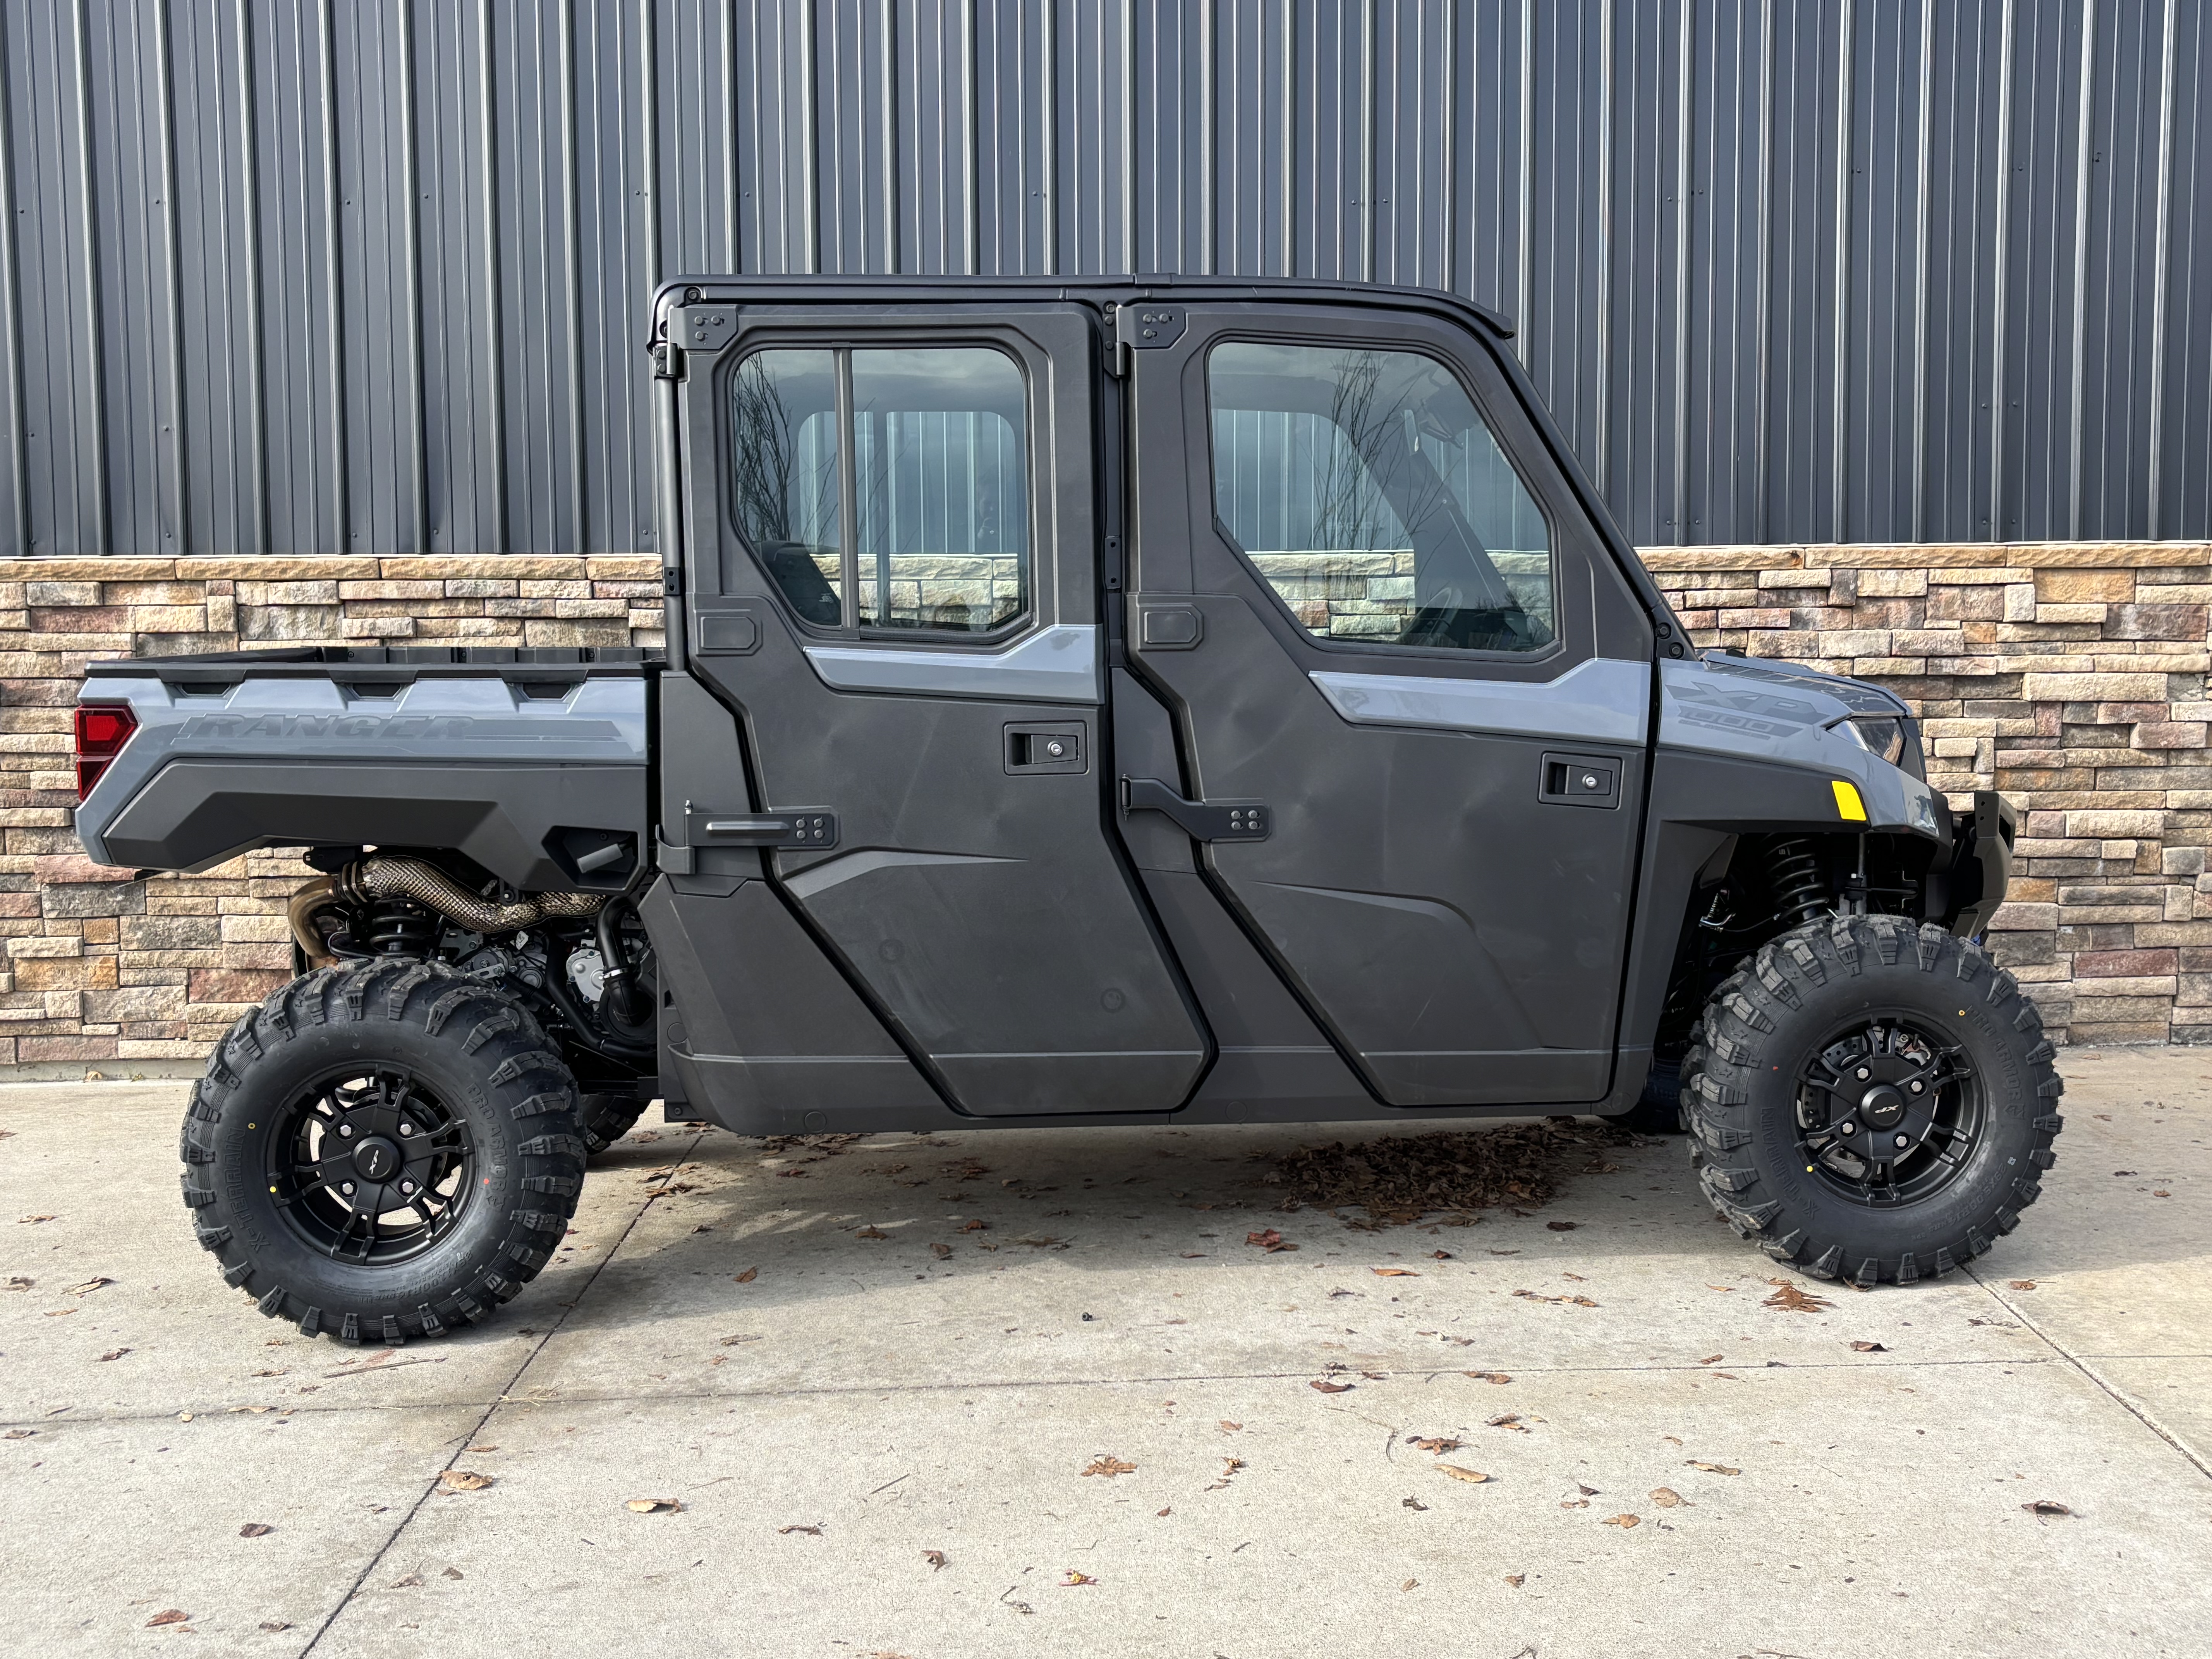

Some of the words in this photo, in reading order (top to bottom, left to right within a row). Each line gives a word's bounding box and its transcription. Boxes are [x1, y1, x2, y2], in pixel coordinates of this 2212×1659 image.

[1674, 681, 1819, 715] XP
[194, 713, 475, 739] RANGER
[1679, 706, 1775, 733] 1000
[1992, 1039, 2022, 1101] ARMOR
[1875, 1105, 1899, 1113] XP
[467, 1083, 495, 1120] PRO
[487, 1121, 507, 1192] ARMOR
[369, 1150, 379, 1175] XP
[1761, 1109, 1820, 1218] X-TERRAIN
[226, 1128, 270, 1252] X-TERRAIN
